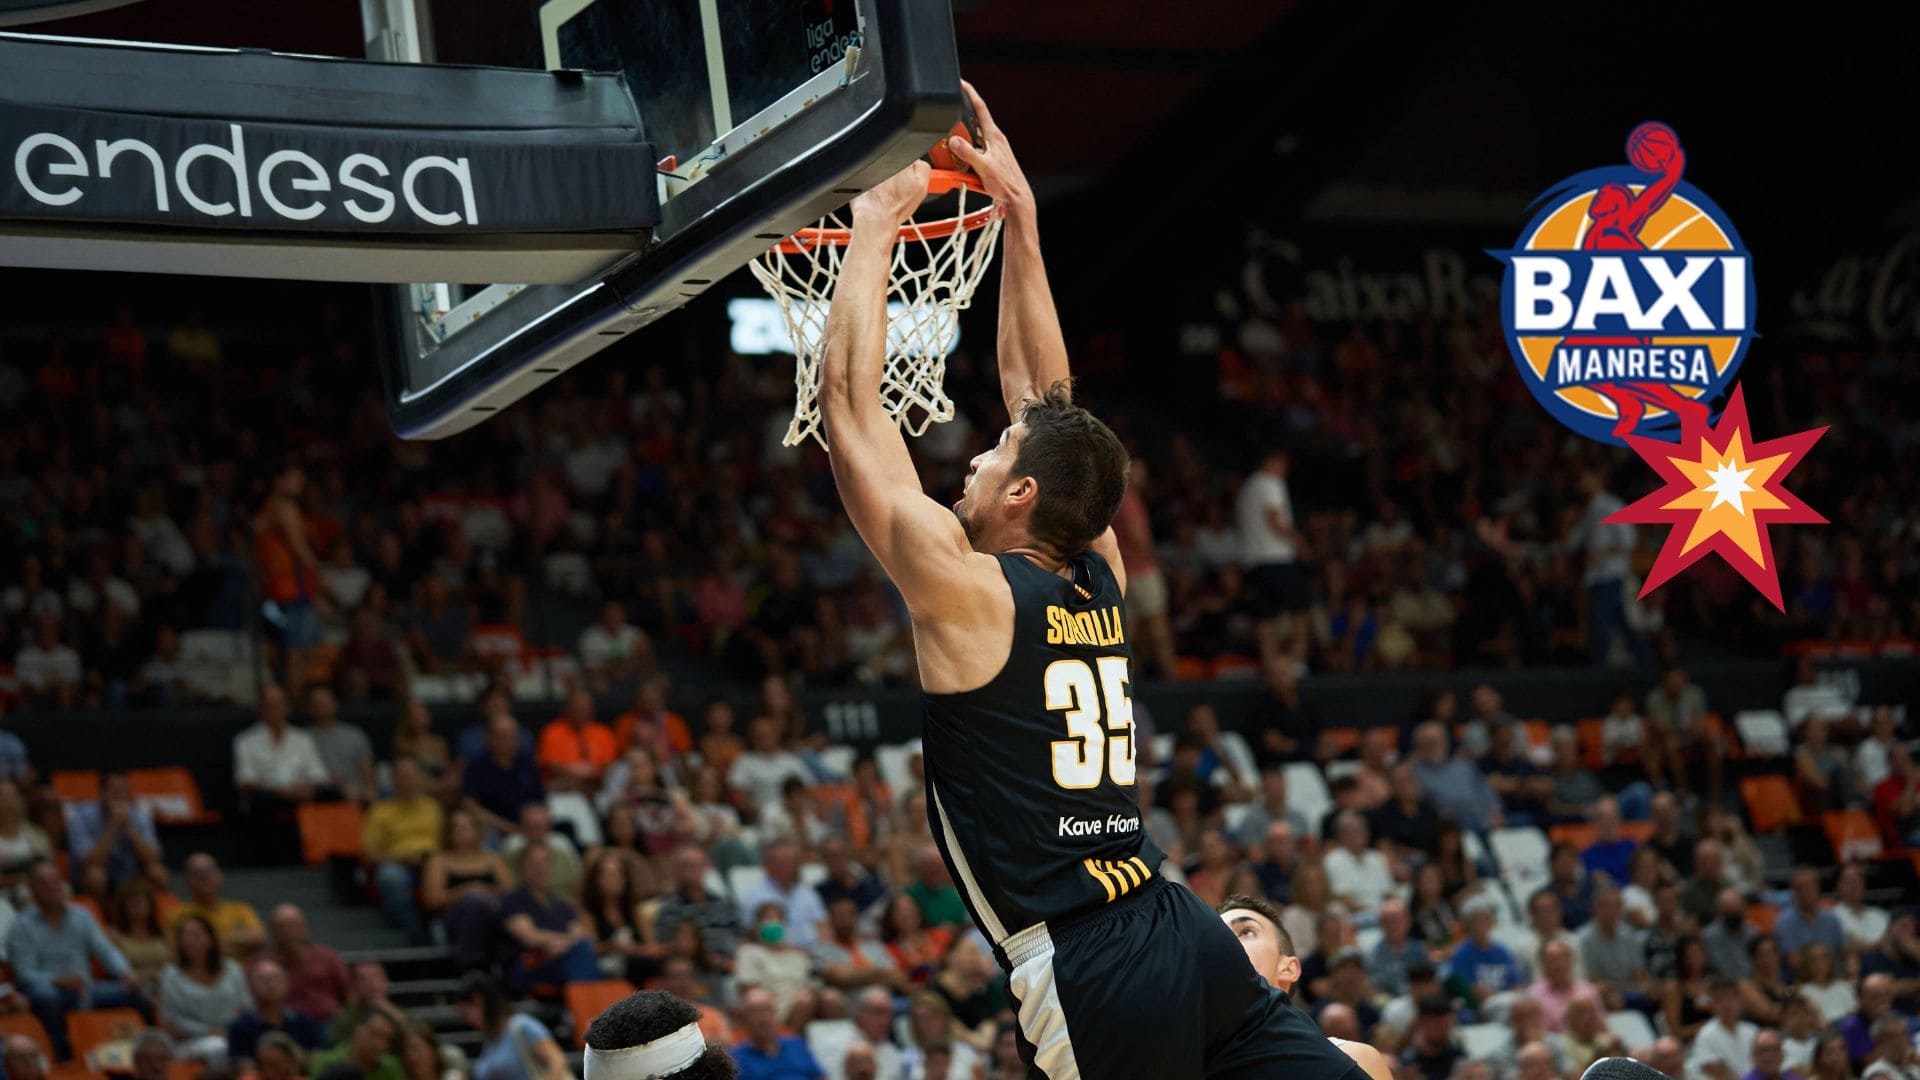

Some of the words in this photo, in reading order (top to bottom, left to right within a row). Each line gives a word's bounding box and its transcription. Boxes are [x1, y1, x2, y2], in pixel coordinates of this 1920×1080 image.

[806, 18, 834, 49] liga
[14, 123, 479, 226] endesa
[1044, 656, 1137, 789] 35
[1058, 816, 1102, 837] Kave
[1106, 814, 1140, 833] Home
